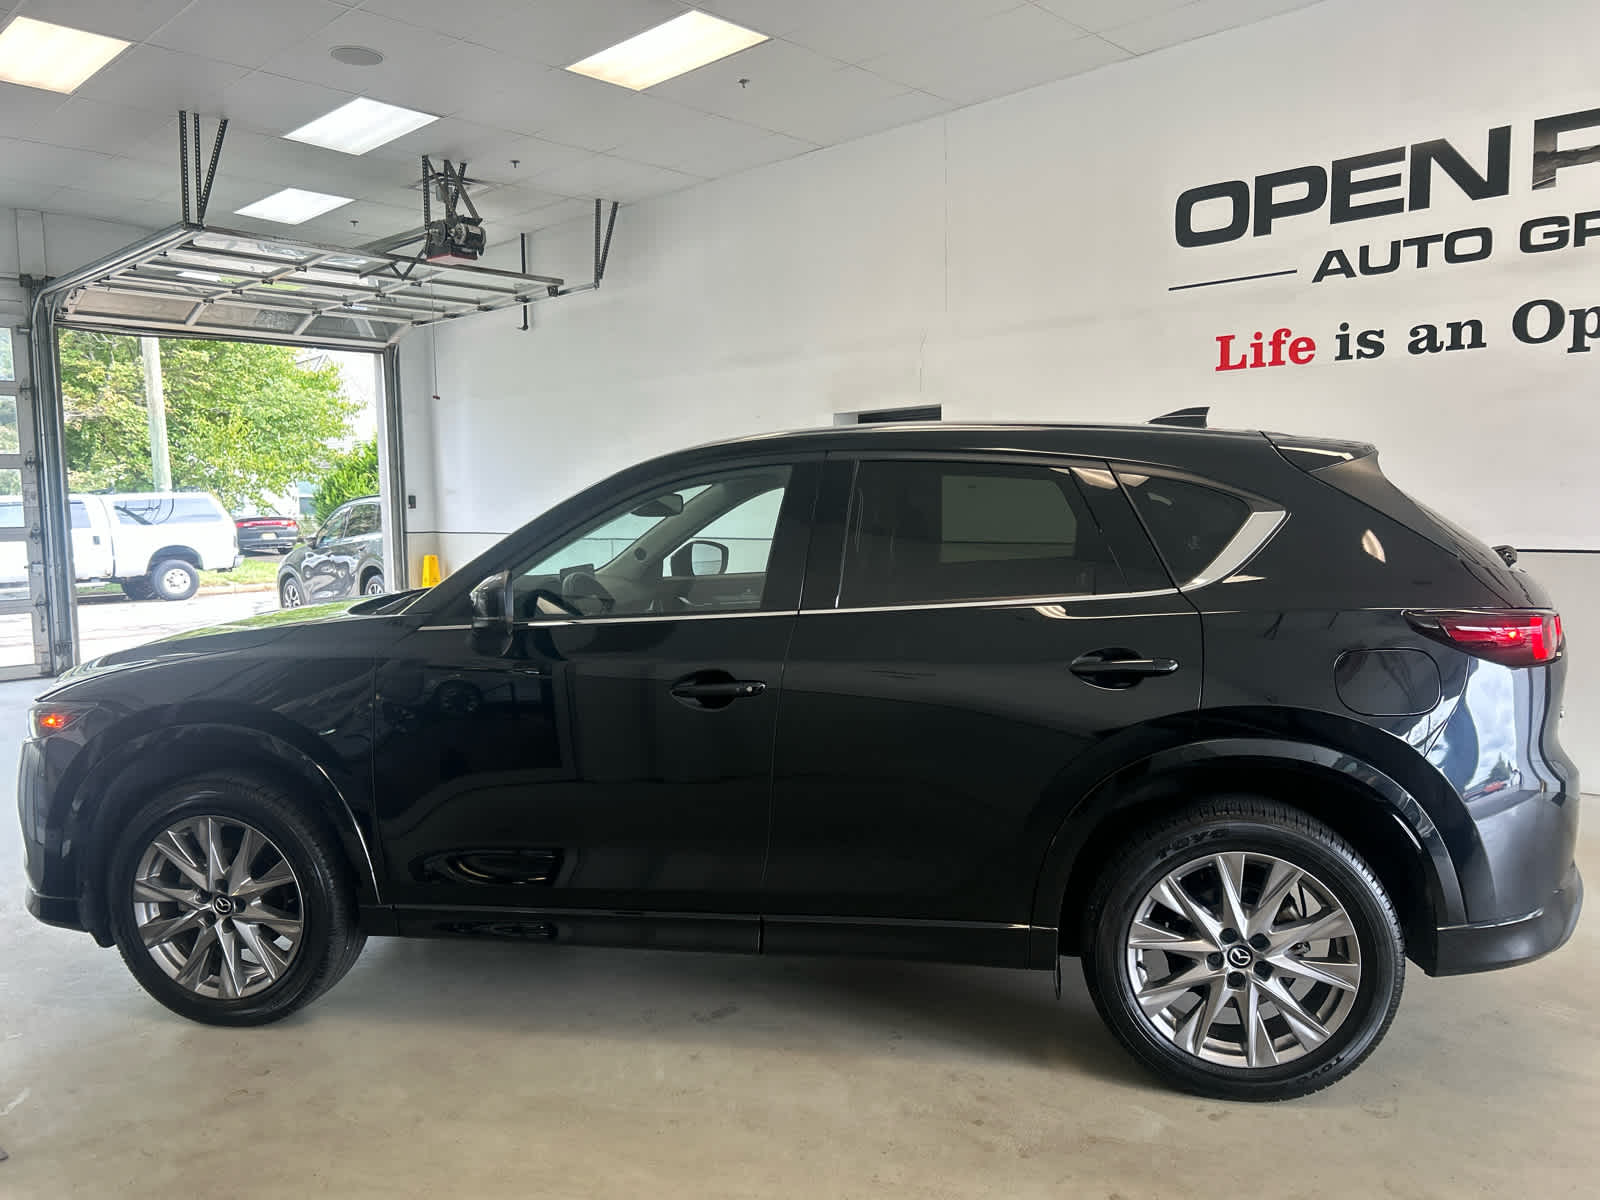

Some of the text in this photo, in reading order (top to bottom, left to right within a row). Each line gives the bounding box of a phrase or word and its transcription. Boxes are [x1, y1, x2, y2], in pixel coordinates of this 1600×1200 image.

[1174, 124, 1512, 248] OPEN
[1311, 226, 1493, 284] AUTO
[1215, 327, 1316, 372] Life
[1334, 322, 1385, 361] is
[1407, 319, 1487, 355] an
